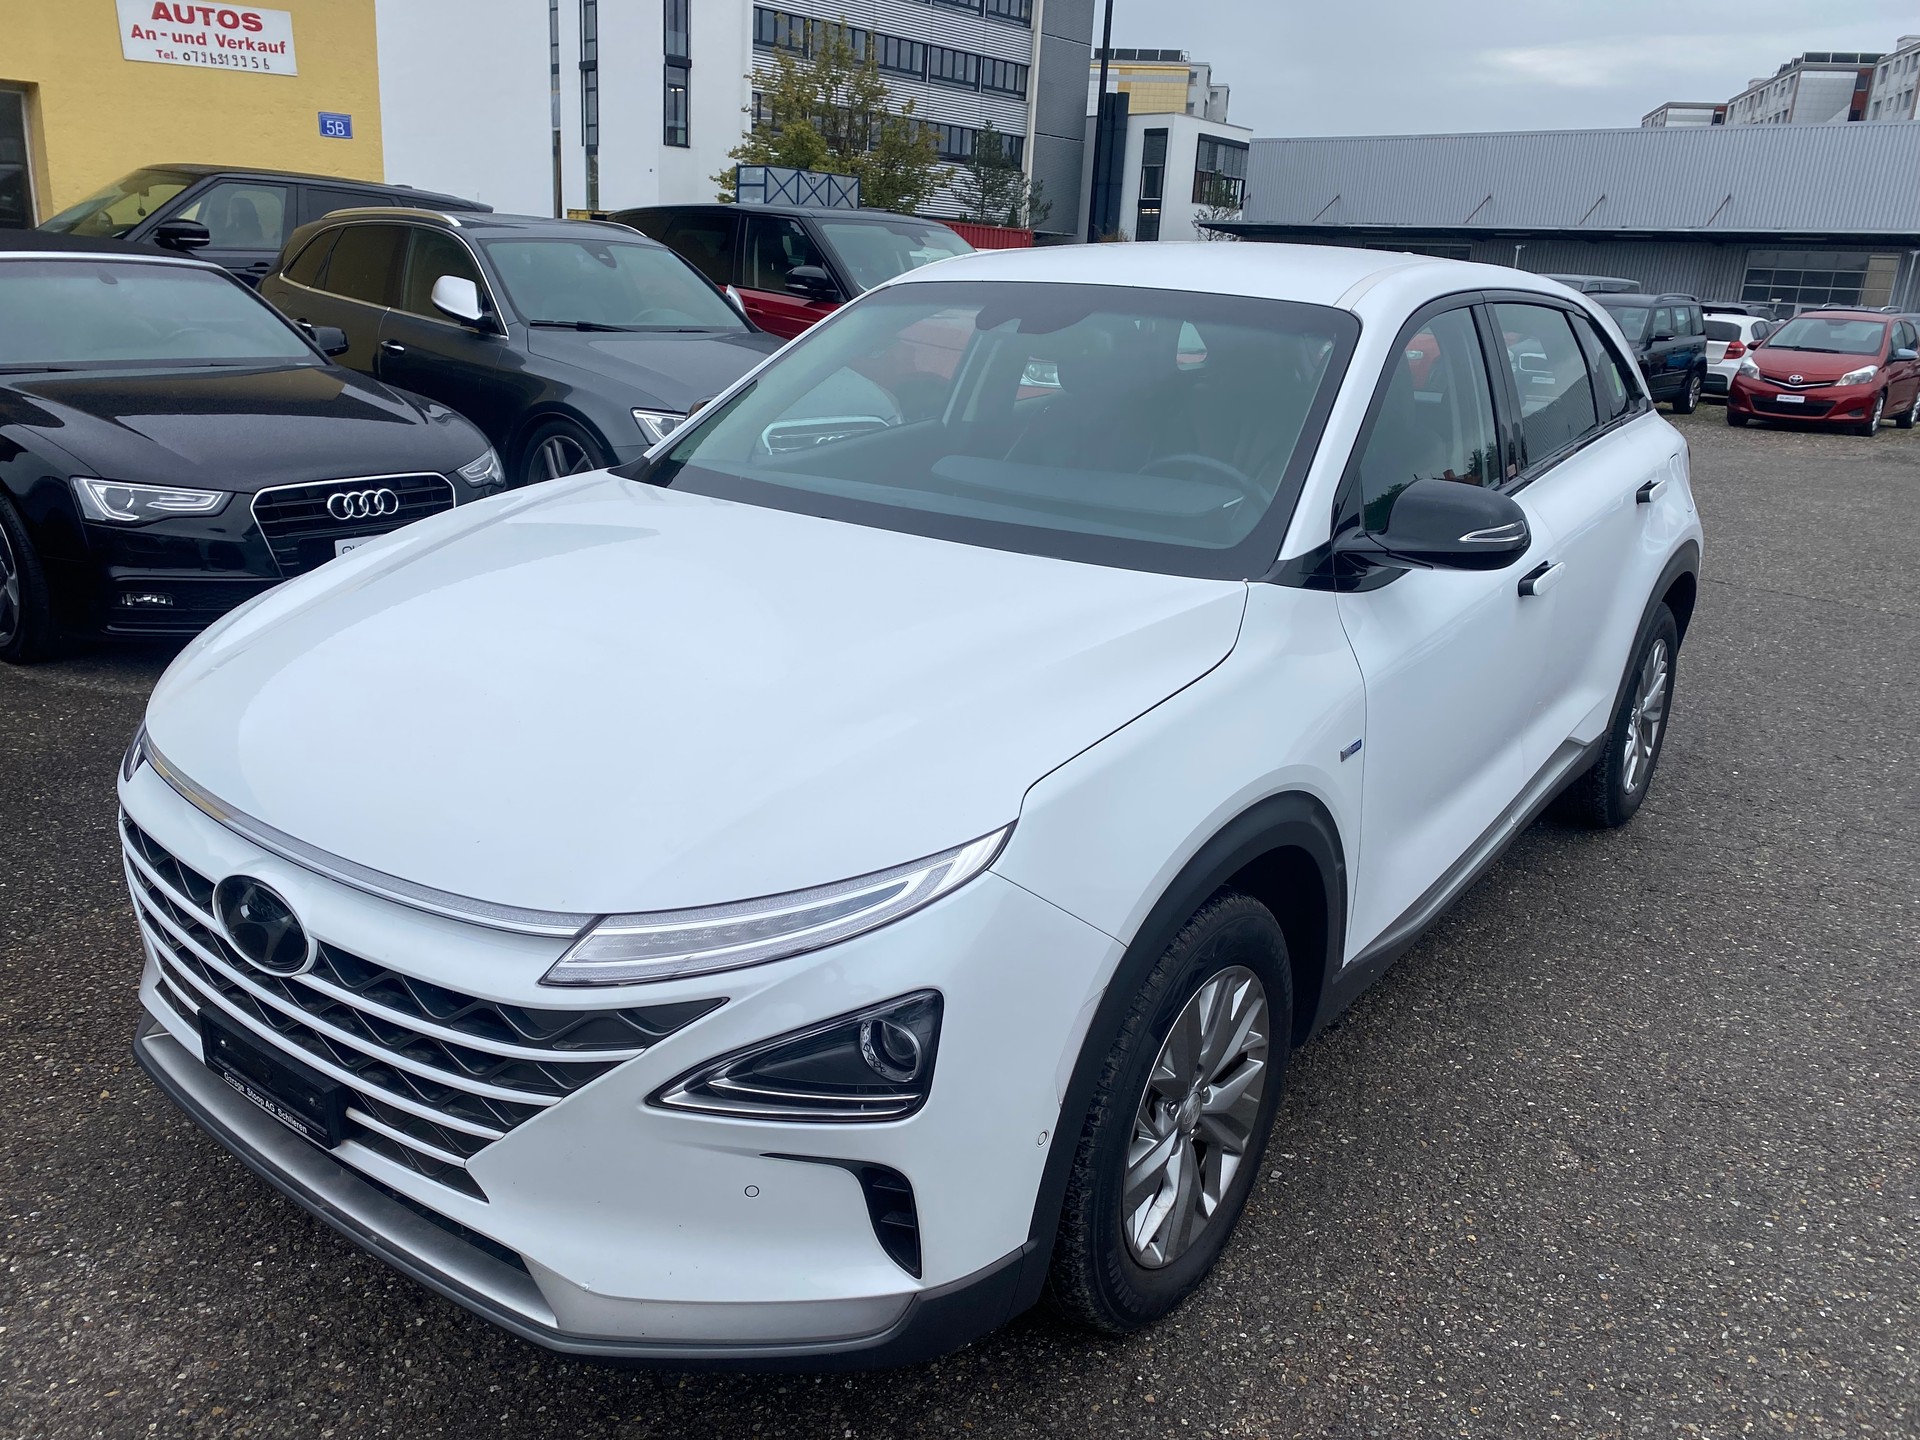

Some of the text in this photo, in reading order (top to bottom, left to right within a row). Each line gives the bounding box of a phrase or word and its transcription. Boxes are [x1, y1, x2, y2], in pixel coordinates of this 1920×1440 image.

[151, 1, 263, 32] AUTOS
[215, 33, 286, 54] Verkauf
[156, 49, 178, 60] Tel.
[326, 120, 345, 136] 5B
[223, 1071, 245, 1092] Garage
[265, 1100, 275, 1113] AG
[277, 1108, 308, 1134] Schlieren
